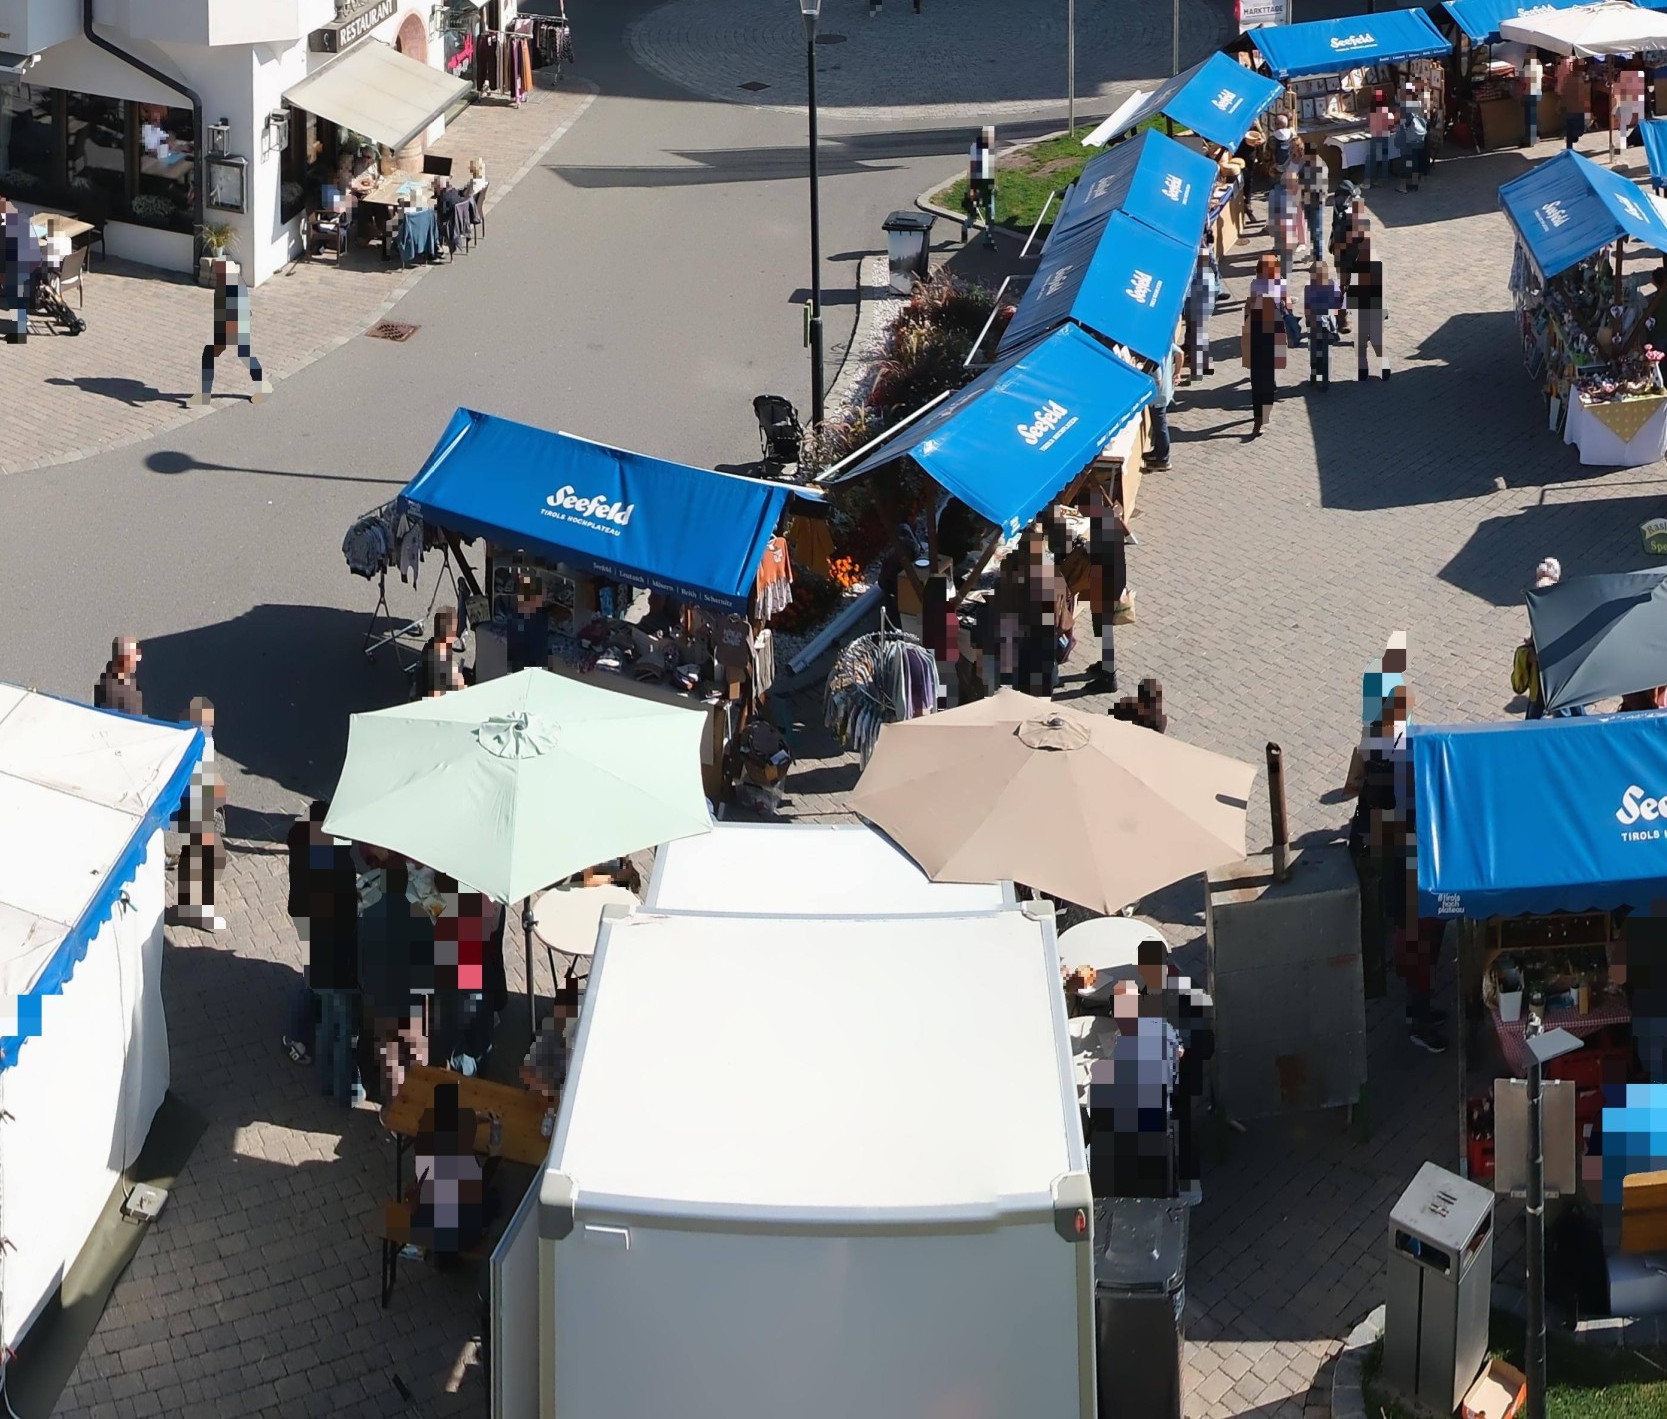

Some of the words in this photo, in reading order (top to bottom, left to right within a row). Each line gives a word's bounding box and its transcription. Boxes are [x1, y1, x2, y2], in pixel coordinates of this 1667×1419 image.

[1243, 5, 1283, 16] MARKTTAGE
[1330, 32, 1375, 50] Seefeld
[1161, 174, 1183, 202] Seefeld
[1125, 269, 1153, 304] Seefeld
[1017, 400, 1069, 445] Seefeld
[546, 485, 635, 526] Seefeld
[540, 508, 566, 521] TIROLS
[567, 515, 622, 537] HOCHPLATEAU
[1621, 829, 1660, 842] TIROLS
